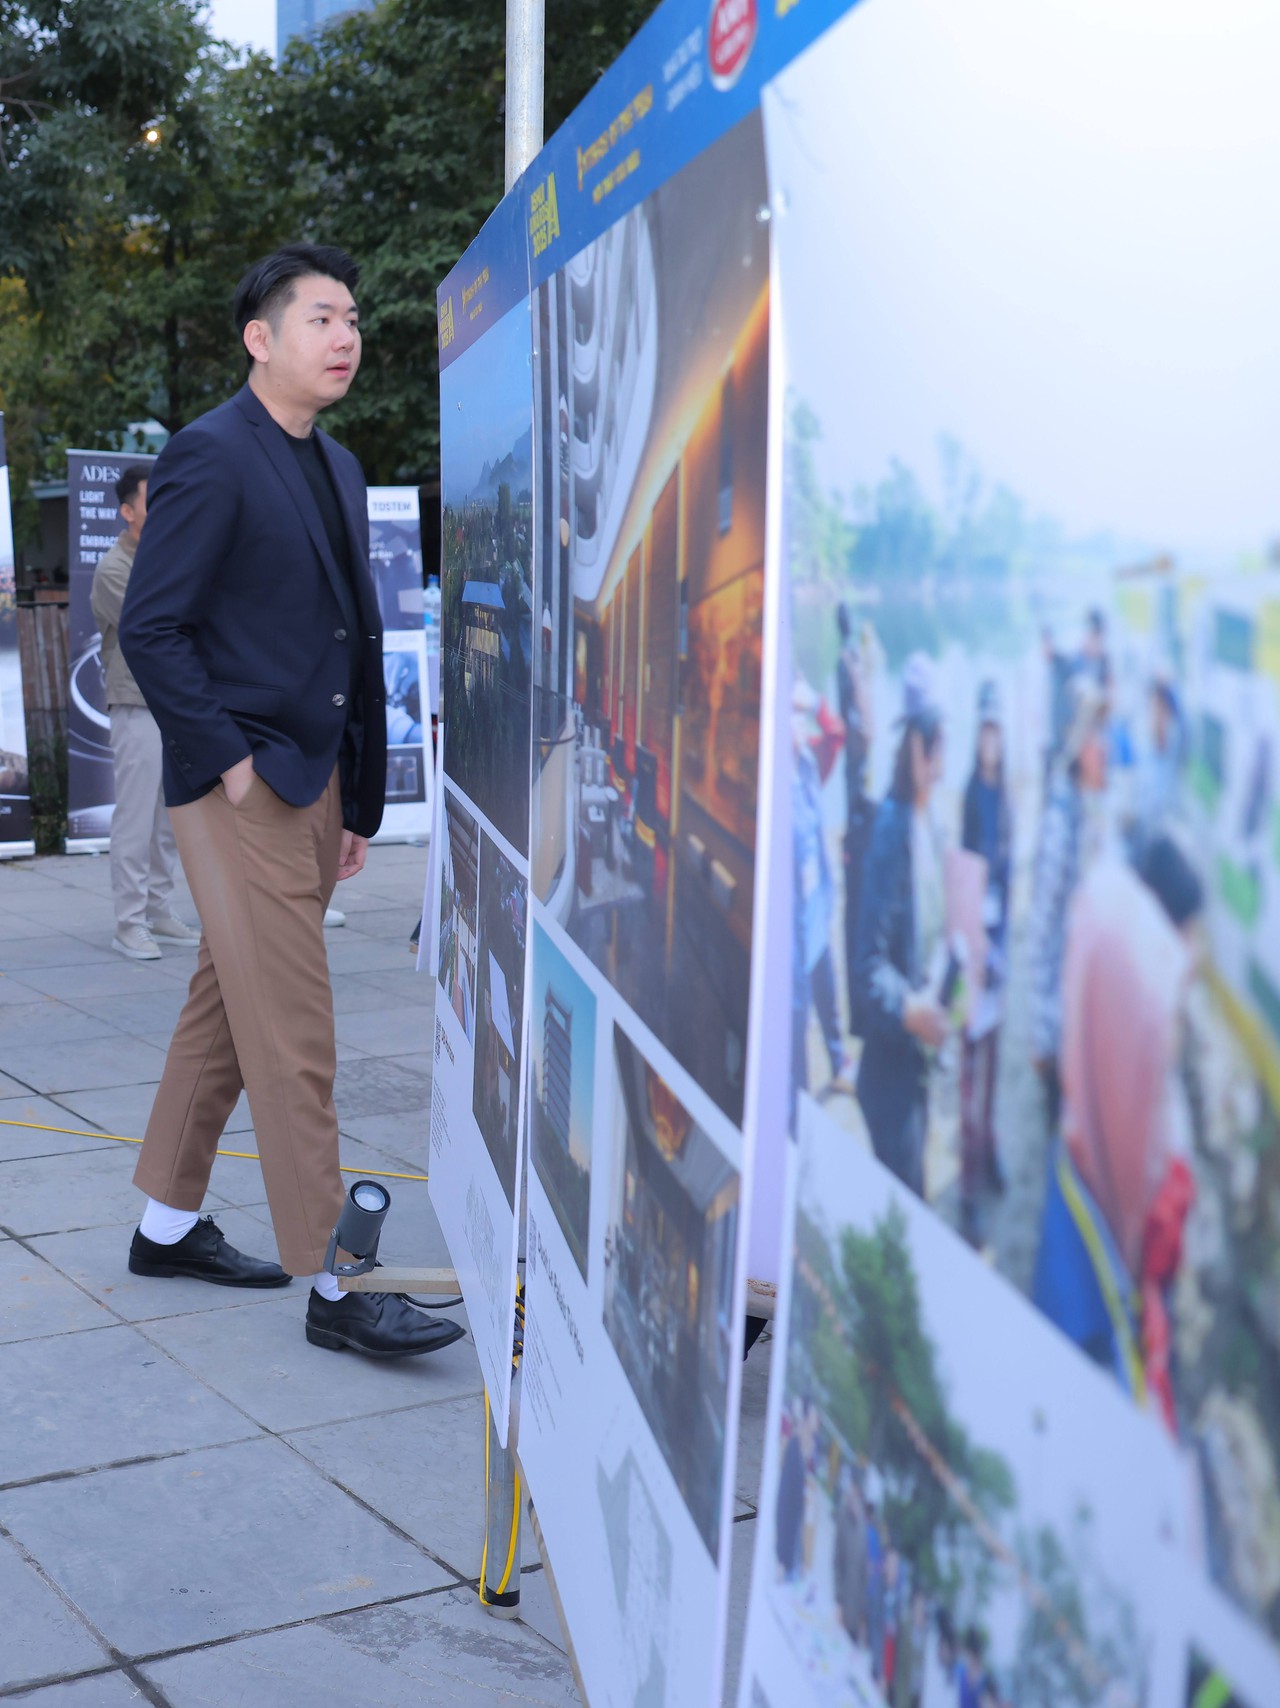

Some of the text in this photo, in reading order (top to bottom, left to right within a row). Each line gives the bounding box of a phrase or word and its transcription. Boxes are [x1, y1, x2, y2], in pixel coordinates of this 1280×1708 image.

[80, 465, 120, 483] ADES
[79, 490, 105, 503] LIGHT
[372, 501, 412, 511] TOSTEM
[80, 506, 118, 520] THE WAY
[80, 551, 97, 563] THE
